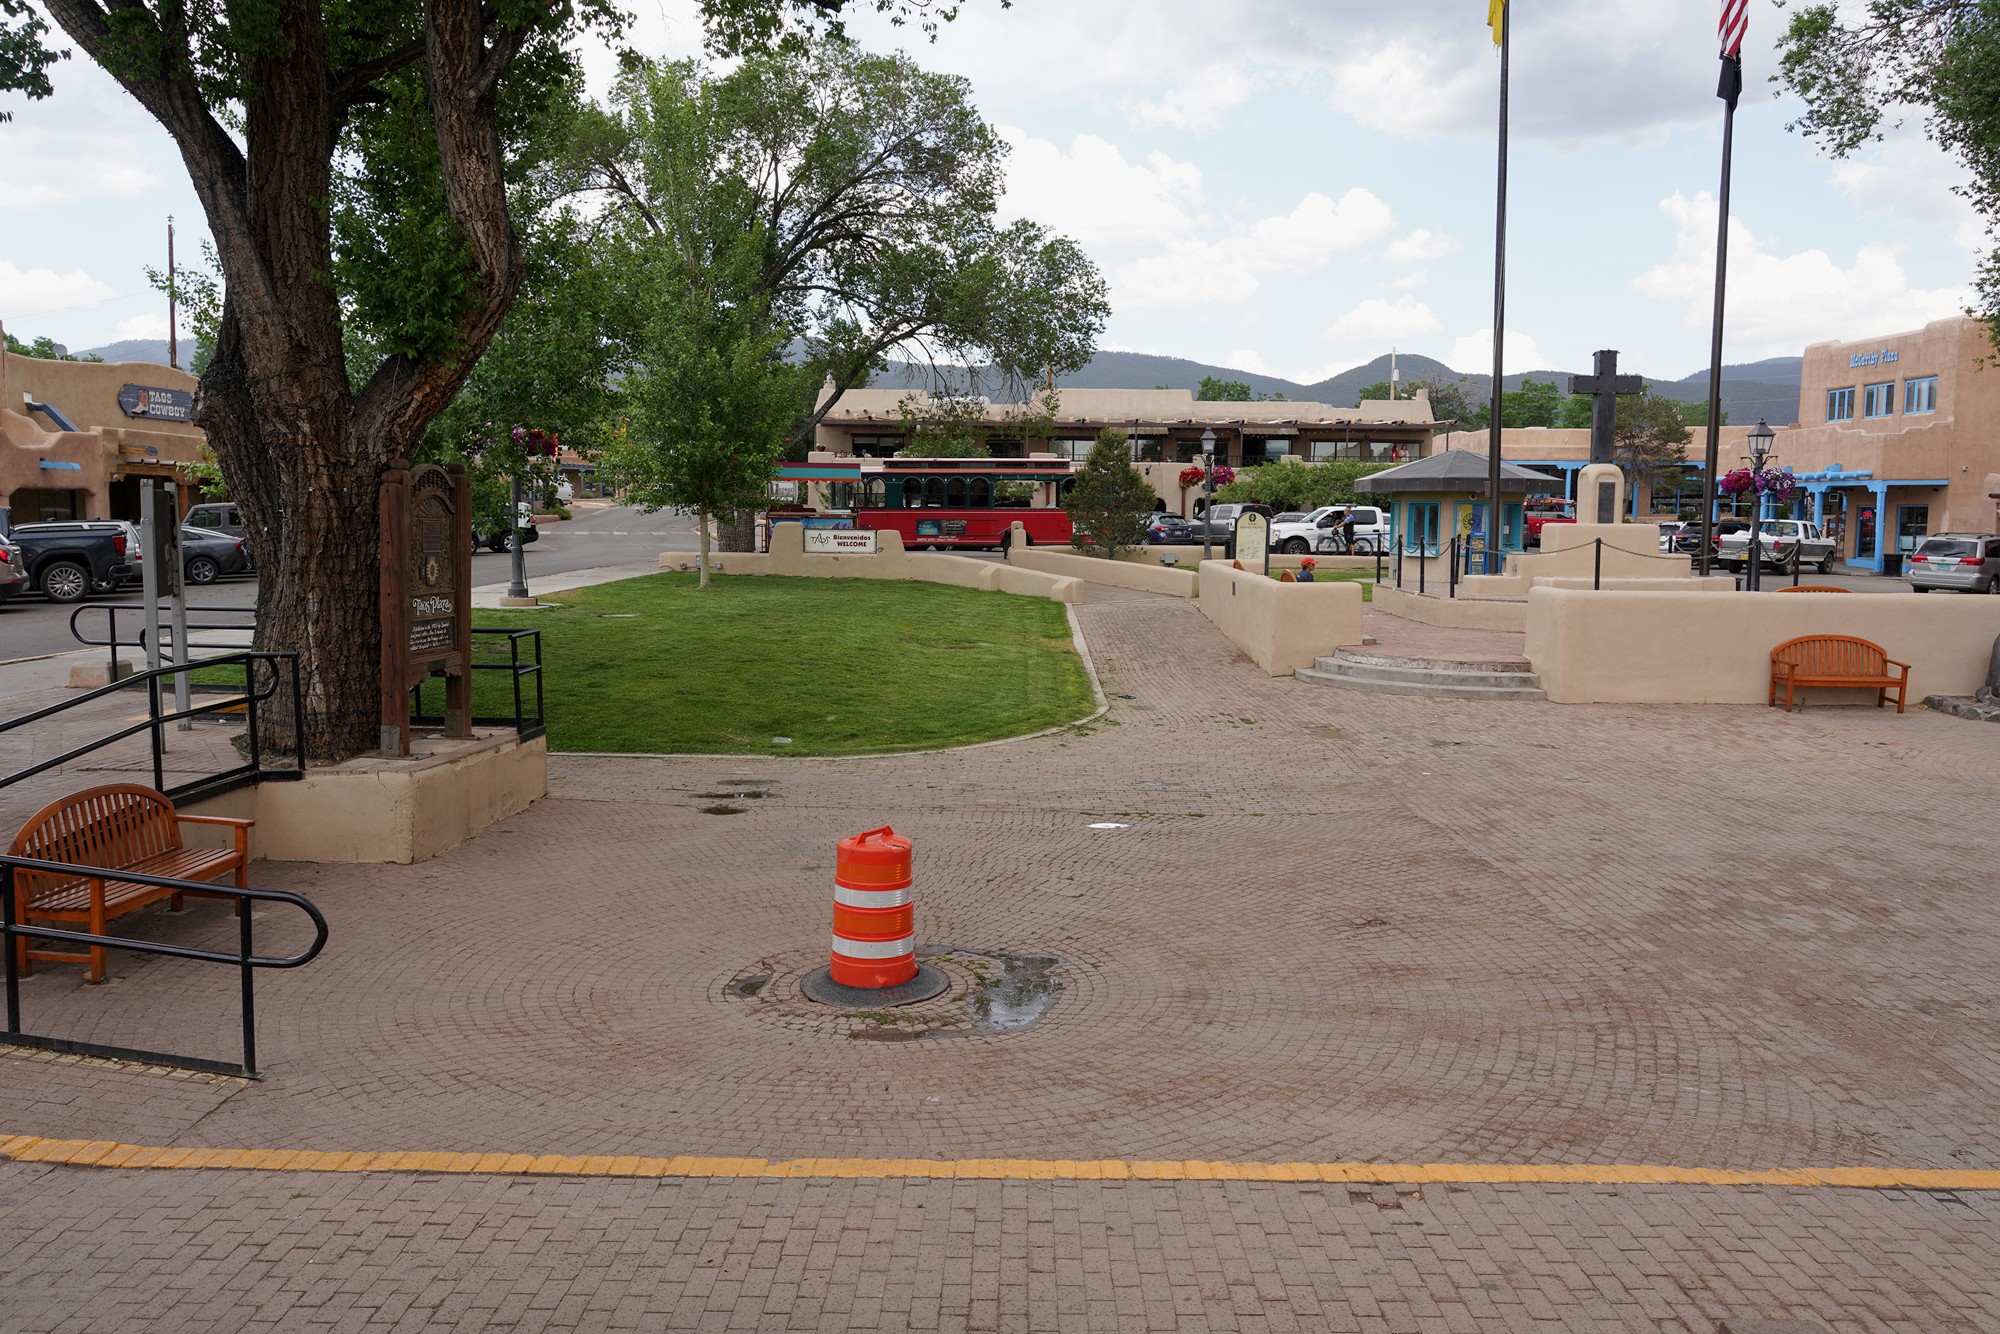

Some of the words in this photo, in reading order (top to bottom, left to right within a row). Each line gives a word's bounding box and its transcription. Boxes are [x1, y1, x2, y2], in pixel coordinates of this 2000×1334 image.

[1881, 349, 1899, 363] Plaza
[149, 391, 172, 404] TAOS
[150, 404, 186, 417] COWBOY
[412, 598, 430, 615] Taos
[430, 596, 452, 613] Plaza
